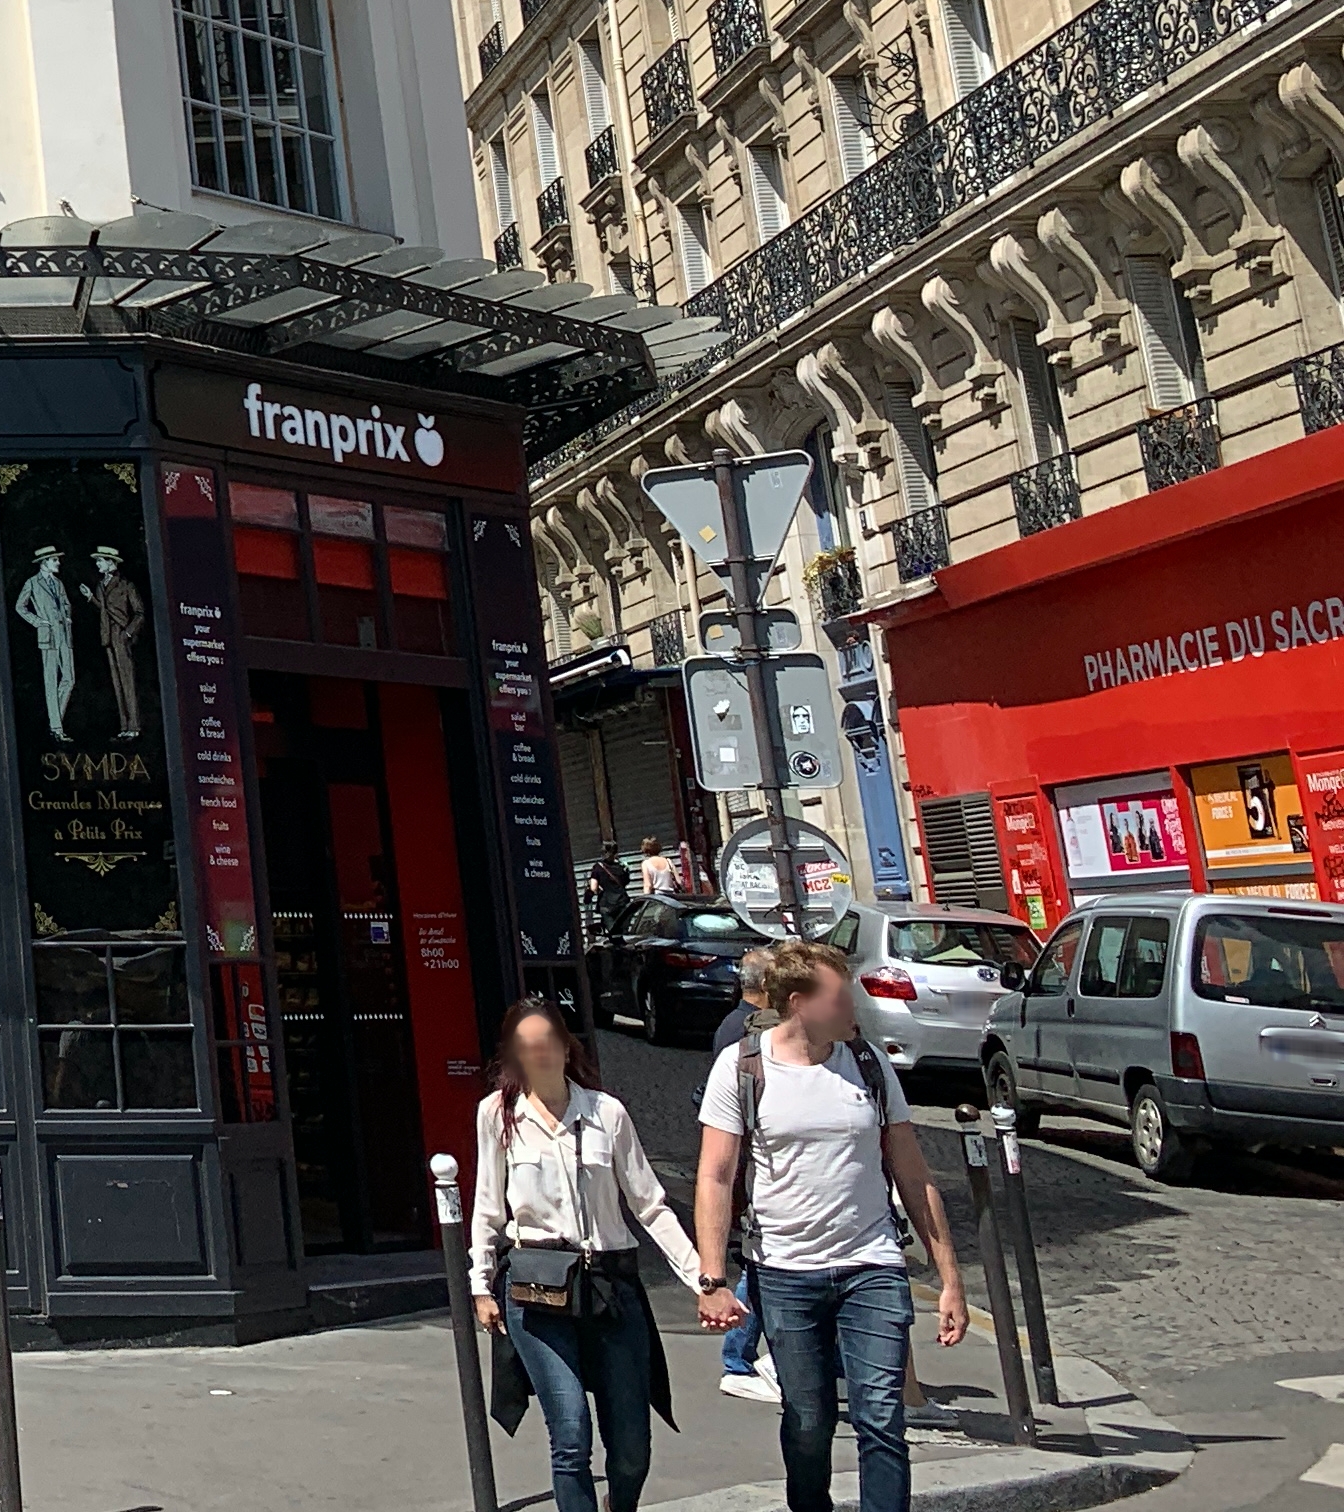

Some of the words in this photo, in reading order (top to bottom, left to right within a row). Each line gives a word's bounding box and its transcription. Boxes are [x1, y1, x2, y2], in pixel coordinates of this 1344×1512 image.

[244, 384, 410, 462] franprix
[180, 603, 213, 619] franprix
[195, 625, 210, 635] your
[183, 639, 225, 651] supermarket
[492, 640, 521, 654] franprix
[187, 653, 206, 664] offers
[1083, 626, 1224, 692] PHARMACIE
[1225, 615, 1266, 663] DU
[495, 672, 532, 683] supermarket
[200, 684, 216, 694] salad
[203, 695, 214, 704] bar
[202, 717, 221, 728] coffee
[511, 713, 526, 722] salad
[207, 729, 225, 739] bread
[514, 743, 531, 753] coffee
[197, 752, 211, 761] cold
[212, 753, 232, 763] drinks
[518, 754, 535, 763] bread
[41, 752, 151, 781] SYMPA
[198, 775, 235, 786] sandwiches
[510, 774, 523, 783] cold
[524, 775, 542, 784] drinks
[28, 790, 92, 811] Grandes
[97, 790, 162, 816] Marques
[200, 796, 221, 808] french
[221, 798, 237, 809] food
[512, 795, 545, 805] sandwiches
[67, 818, 106, 840] Petits
[111, 817, 144, 840] Prix
[212, 820, 229, 831] fruits
[215, 844, 230, 854] wine
[216, 855, 239, 867] cheese
[531, 869, 551, 879] cheese
[430, 958, 459, 969] 21h00
